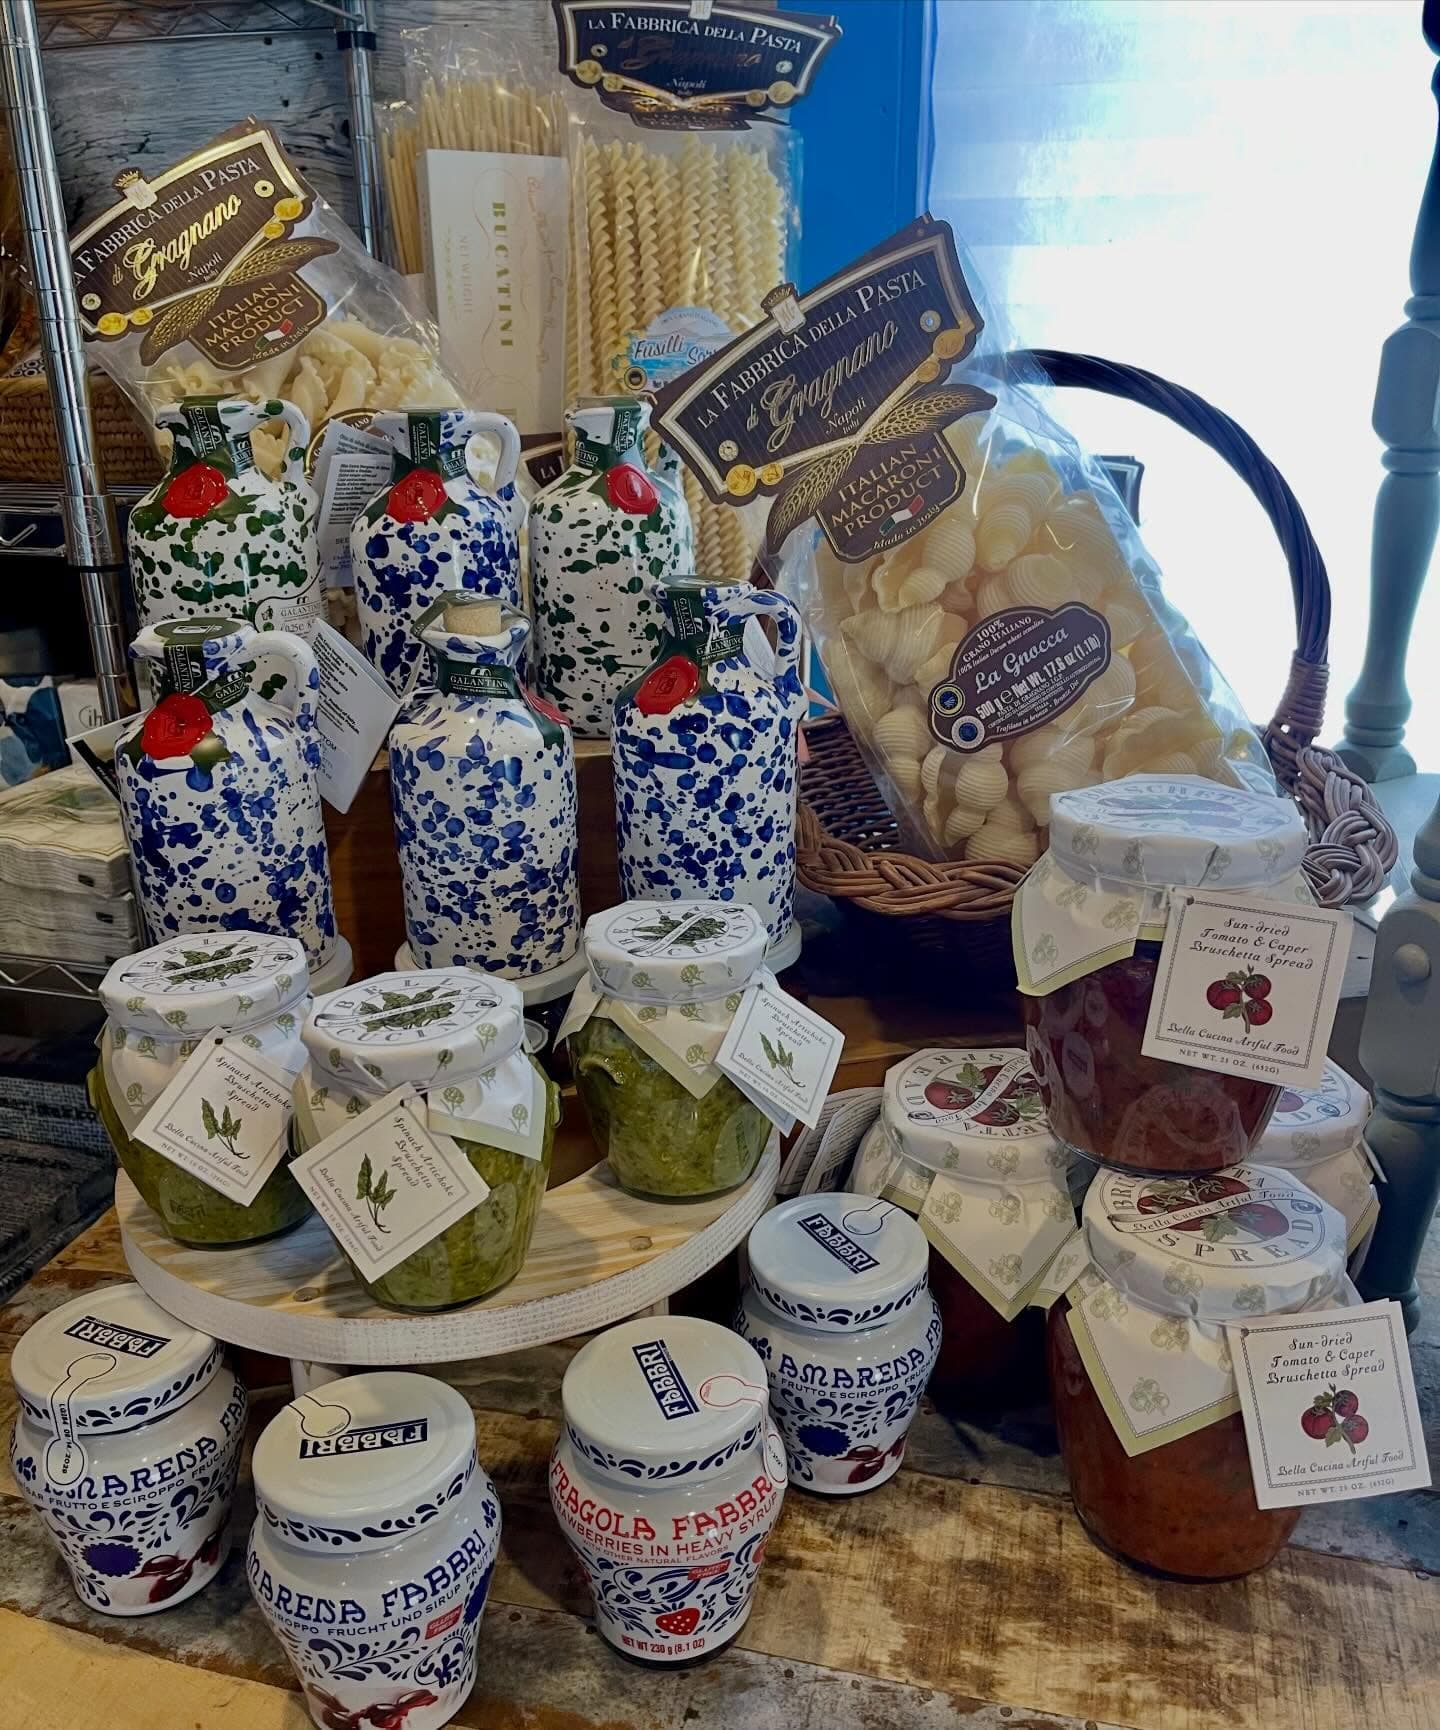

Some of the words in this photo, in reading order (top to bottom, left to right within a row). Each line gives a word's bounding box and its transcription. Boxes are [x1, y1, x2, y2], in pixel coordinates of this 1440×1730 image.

[588, 19, 606, 30] LA
[609, 12, 700, 36] FABBRICA
[704, 26, 745, 42] DELLA
[749, 27, 802, 54] PASTA
[75, 207, 163, 273] FABBRICA
[161, 186, 204, 214] DELLA
[199, 157, 261, 192] PASTA
[112, 264, 124, 286] di
[122, 193, 242, 300] Gragnano
[187, 252, 223, 283] Napoli
[492, 201, 514, 346] BUCATINI
[205, 283, 300, 347] MACARONI
[208, 282, 277, 329] ITALIAN
[220, 297, 304, 353] PRODUCT
[252, 346, 280, 360] Made
[289, 326, 309, 342] Italy
[634, 334, 685, 360] Fusilli
[697, 407, 719, 429] LA
[710, 331, 808, 411] FABBRICA
[808, 306, 858, 342] DELLA
[855, 268, 927, 314] PASTA
[746, 402, 759, 432] di
[760, 319, 899, 452] Gragnano
[825, 397, 867, 435] Napoli
[540, 465, 556, 480] LA
[831, 447, 942, 528] MACARONI
[838, 444, 918, 502] ITALIAN
[844, 464, 943, 537] PRODUCT
[873, 532, 903, 550] Made
[905, 522, 917, 534] in
[918, 505, 940, 526] Italy
[962, 639, 991, 663] GRANO
[991, 616, 1032, 642] ITALIANO
[976, 619, 1005, 642] 100%
[450, 674, 509, 688] GALANTINO
[975, 668, 1002, 694] La
[1002, 627, 1069, 677] Gnocca
[975, 700, 995, 720] 500
[1011, 679, 1031, 699] Net
[1043, 658, 1066, 679] 17.6
[1064, 652, 1078, 665] oz
[1200, 927, 1249, 946] Tomato
[1253, 935, 1266, 947] &
[1268, 938, 1309, 955] Caper
[1223, 916, 1291, 937] Sun-dried
[1189, 940, 1261, 963] Bruschetta
[1264, 951, 1314, 971] Spread
[336, 1008, 481, 1042] CUCINA
[1167, 1021, 1195, 1037] Bella
[1198, 1029, 1233, 1044] Cucina
[1234, 1034, 1272, 1053] Artful
[1272, 1042, 1300, 1057] Food
[1179, 1048, 1199, 1059] NET
[216, 1056, 250, 1081] Spinach
[251, 1080, 292, 1110] Artichoke
[224, 1074, 271, 1109] Bruschetta
[227, 1089, 259, 1112] Spread
[164, 1122, 185, 1138] Bella
[185, 1135, 208, 1153] Cucina
[393, 1115, 424, 1153] Spinach
[420, 1151, 456, 1198] Artichoke
[391, 1154, 419, 1188] Spread
[395, 1139, 433, 1190] Bruschetta
[319, 1167, 336, 1189] Bella
[334, 1187, 352, 1213] Cucina
[350, 1211, 371, 1236] Artful
[1132, 1216, 1172, 1232] Bella
[1172, 1206, 1212, 1222] Cucina
[1215, 1193, 1252, 1211] Artful
[1259, 1190, 1295, 1199] Food
[805, 1215, 879, 1272] FABBRI
[1157, 1218, 1314, 1262] SPREAD
[69, 1320, 164, 1357] FABBRI
[1270, 1354, 1320, 1368] Tomato
[1324, 1351, 1336, 1363] &
[1338, 1349, 1376, 1364] Caper
[1288, 1332, 1353, 1351] Sun-dried
[641, 1342, 689, 1418] FABBRI
[779, 1348, 925, 1389] AMARENA
[781, 1378, 827, 1397] FRUTTO
[830, 1391, 838, 1399] E
[840, 1384, 899, 1399] SCIROPPO
[1266, 1368, 1338, 1385] Bruschetta
[1341, 1359, 1385, 1380] Spread
[306, 1423, 424, 1458] FABBRI
[44, 1436, 218, 1500] MARENA
[49, 1497, 98, 1511] FRUTTO
[101, 1500, 110, 1510] E
[113, 1478, 186, 1509] SCIROPPO
[191, 1443, 234, 1479] FRUCHT
[1277, 1464, 1306, 1477] Bella
[1309, 1461, 1344, 1473] Cucina
[1345, 1454, 1380, 1471] Artful
[1380, 1450, 1404, 1463] Food
[551, 1460, 656, 1541] FRAGOLA
[672, 1475, 773, 1541] FABBR
[1297, 1487, 1317, 1497] NET
[650, 1544, 669, 1557] IN
[677, 1528, 734, 1556] HEAVY
[739, 1491, 778, 1535] SYRUP
[604, 1549, 634, 1561] OTHER
[637, 1556, 681, 1565] NATURAL
[686, 1545, 729, 1562] FLAVORS
[249, 1551, 366, 1625] MARENA
[381, 1529, 487, 1618] FABBRI
[327, 1622, 388, 1637] FRUCHT
[391, 1610, 423, 1628] UND
[425, 1583, 462, 1614] SIRUP
[465, 1551, 490, 1584] FRUIT
[622, 1635, 634, 1647] NET
[637, 1641, 648, 1651] WT
[650, 1644, 666, 1654] 230
[667, 1646, 673, 1655] g
[674, 1642, 690, 1654] (8.1
[692, 1637, 705, 1649] OZ)
